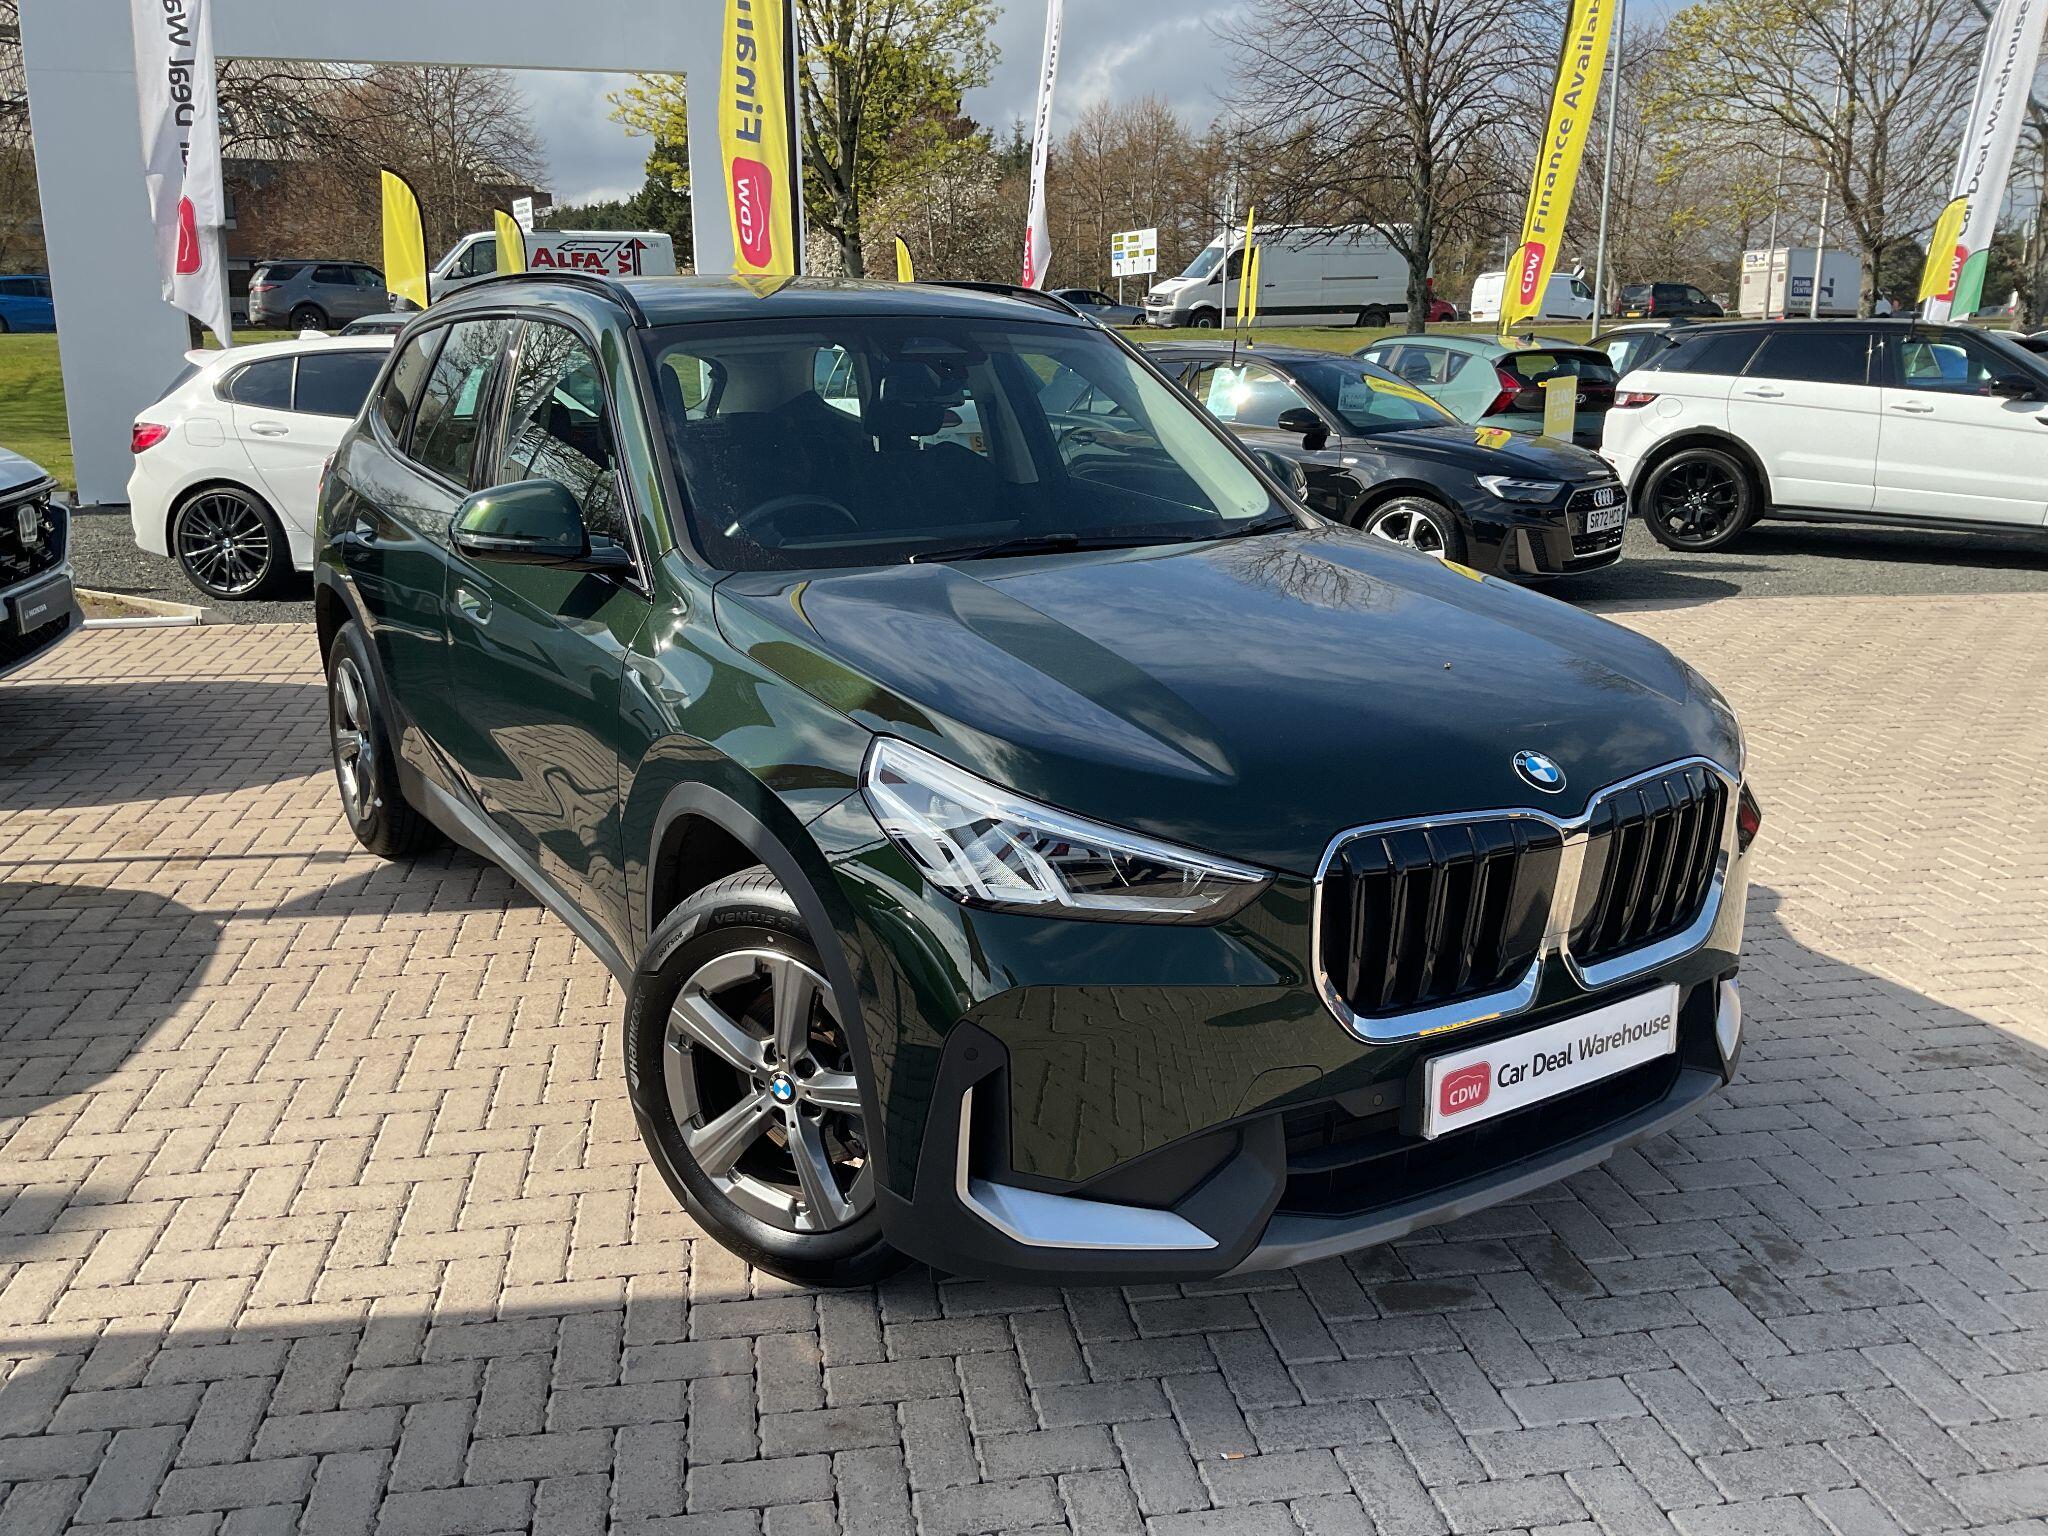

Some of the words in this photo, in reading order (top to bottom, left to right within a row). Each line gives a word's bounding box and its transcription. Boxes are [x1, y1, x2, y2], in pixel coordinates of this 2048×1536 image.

[1967, 144, 1991, 194] Deal
[1984, 1, 2031, 136] Warehouse
[1533, 117, 1573, 233] Finance
[531, 247, 604, 269] ALFA
[1522, 253, 1540, 294] CDW
[1590, 511, 1608, 529] SR72
[29, 603, 47, 617] HONDA
[1449, 1083, 1482, 1106] CDW
[1497, 1061, 1529, 1088] Car
[1532, 1042, 1573, 1077] Deal
[1578, 1013, 1671, 1061] Warehouse
